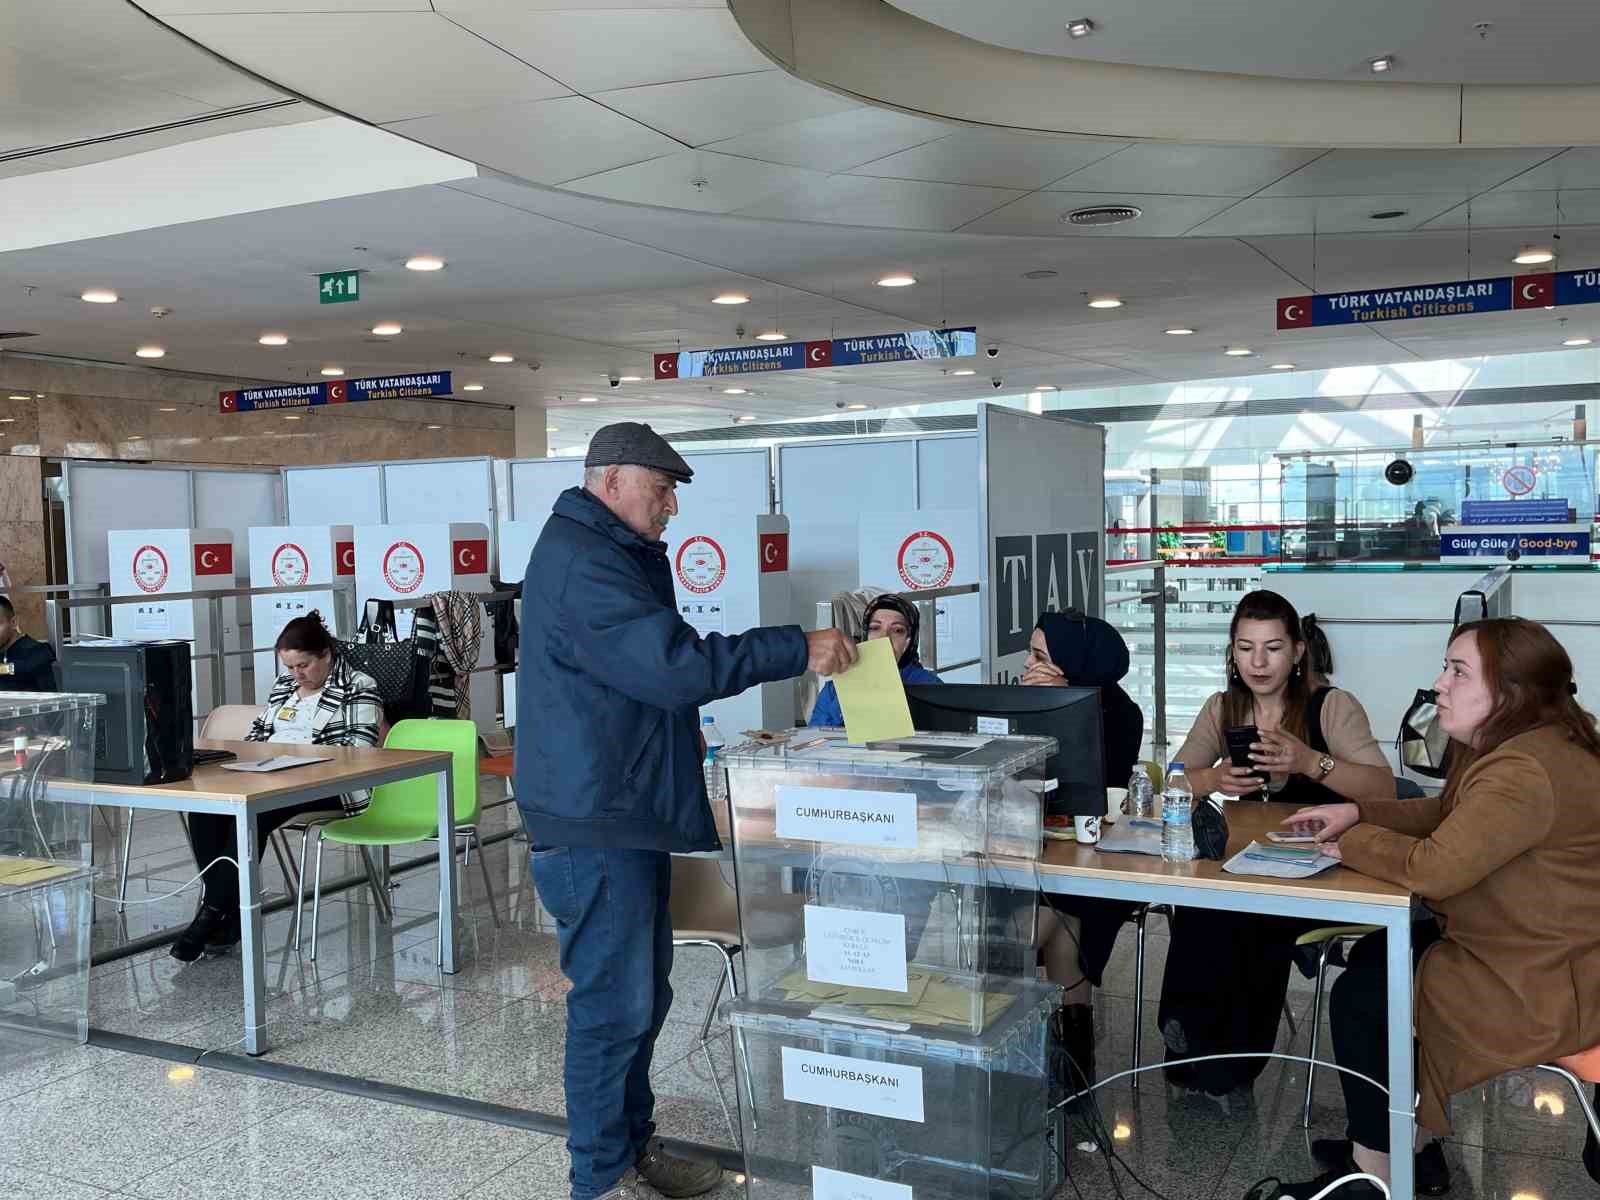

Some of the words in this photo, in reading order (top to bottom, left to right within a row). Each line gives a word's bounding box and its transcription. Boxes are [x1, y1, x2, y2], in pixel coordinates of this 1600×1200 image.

[1573, 271, 1600, 288] TÜ
[1329, 295, 1370, 310] TÜRK
[1374, 283, 1493, 305] VATANDAŞLARI
[1352, 305, 1407, 322] Turkish
[1412, 300, 1475, 317] Citizens
[844, 338, 874, 352] TÜRK
[717, 346, 793, 362] VATANDAŞLARI
[860, 351, 901, 362] Turkish
[742, 360, 783, 372] Citizens
[355, 379, 377, 391] TÜRK
[378, 375, 441, 388] VATANDAŞLARI
[243, 390, 263, 401] TÜRK
[264, 385, 319, 399] VATANDAŞLARI
[368, 388, 398, 399] Turkish
[399, 386, 433, 397] Citizens
[253, 399, 280, 410] Turkish
[281, 397, 311, 409] Citizens
[1451, 538, 1478, 550] Güle
[1480, 538, 1509, 550] Güle
[1518, 537, 1578, 551] Good-bye
[1003, 549, 1095, 635] TAV
[796, 807, 895, 825] CUMHURBAŞKANI
[801, 1063, 900, 1089] CUMHURBAŞKANI
